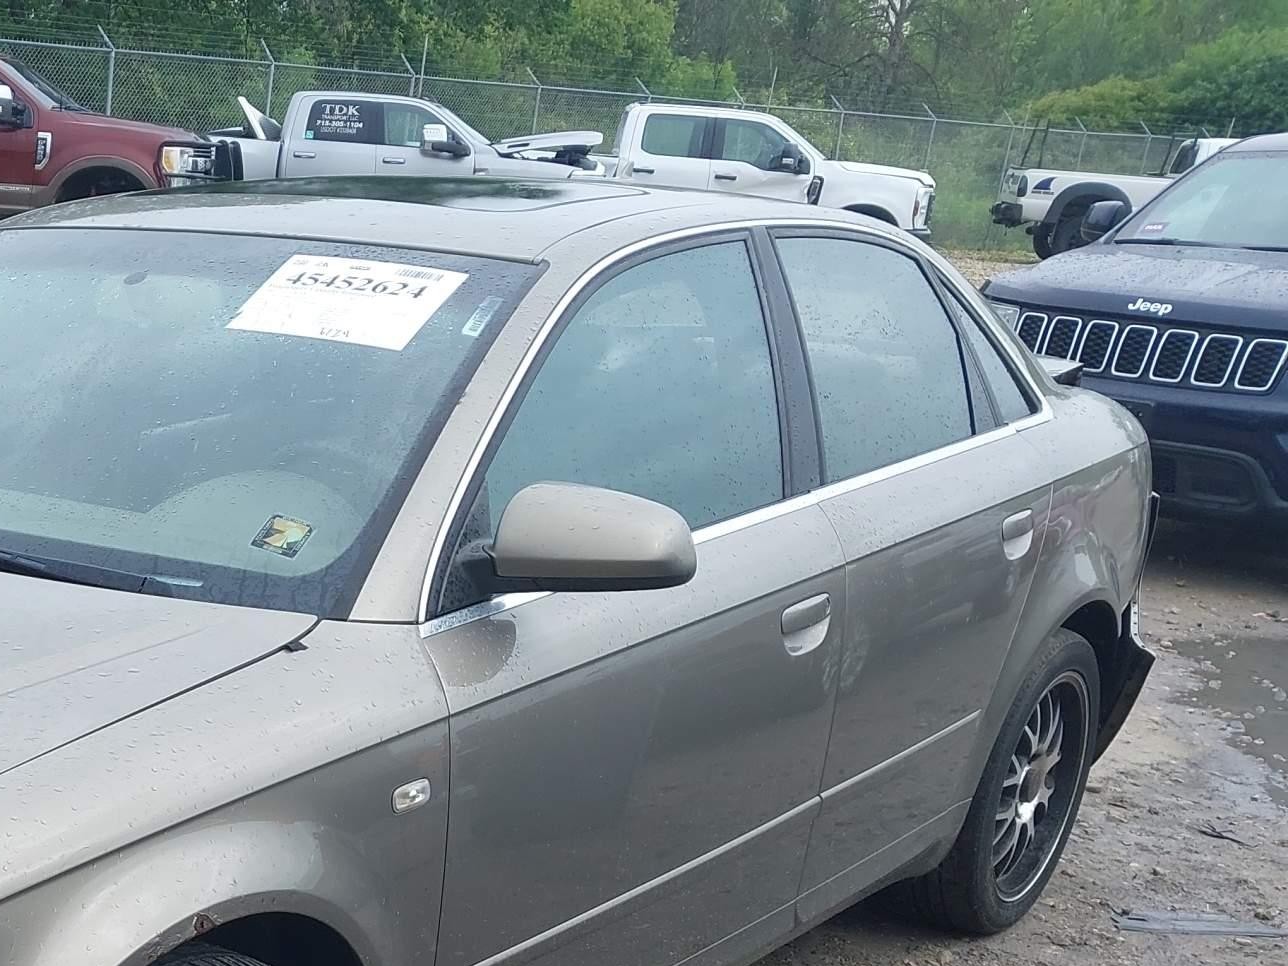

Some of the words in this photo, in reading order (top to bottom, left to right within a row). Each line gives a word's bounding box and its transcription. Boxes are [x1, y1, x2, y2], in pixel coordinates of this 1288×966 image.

[322, 103, 360, 115] TDK
[286, 272, 428, 298] 45452624
[1128, 298, 1172, 315] Jeep
